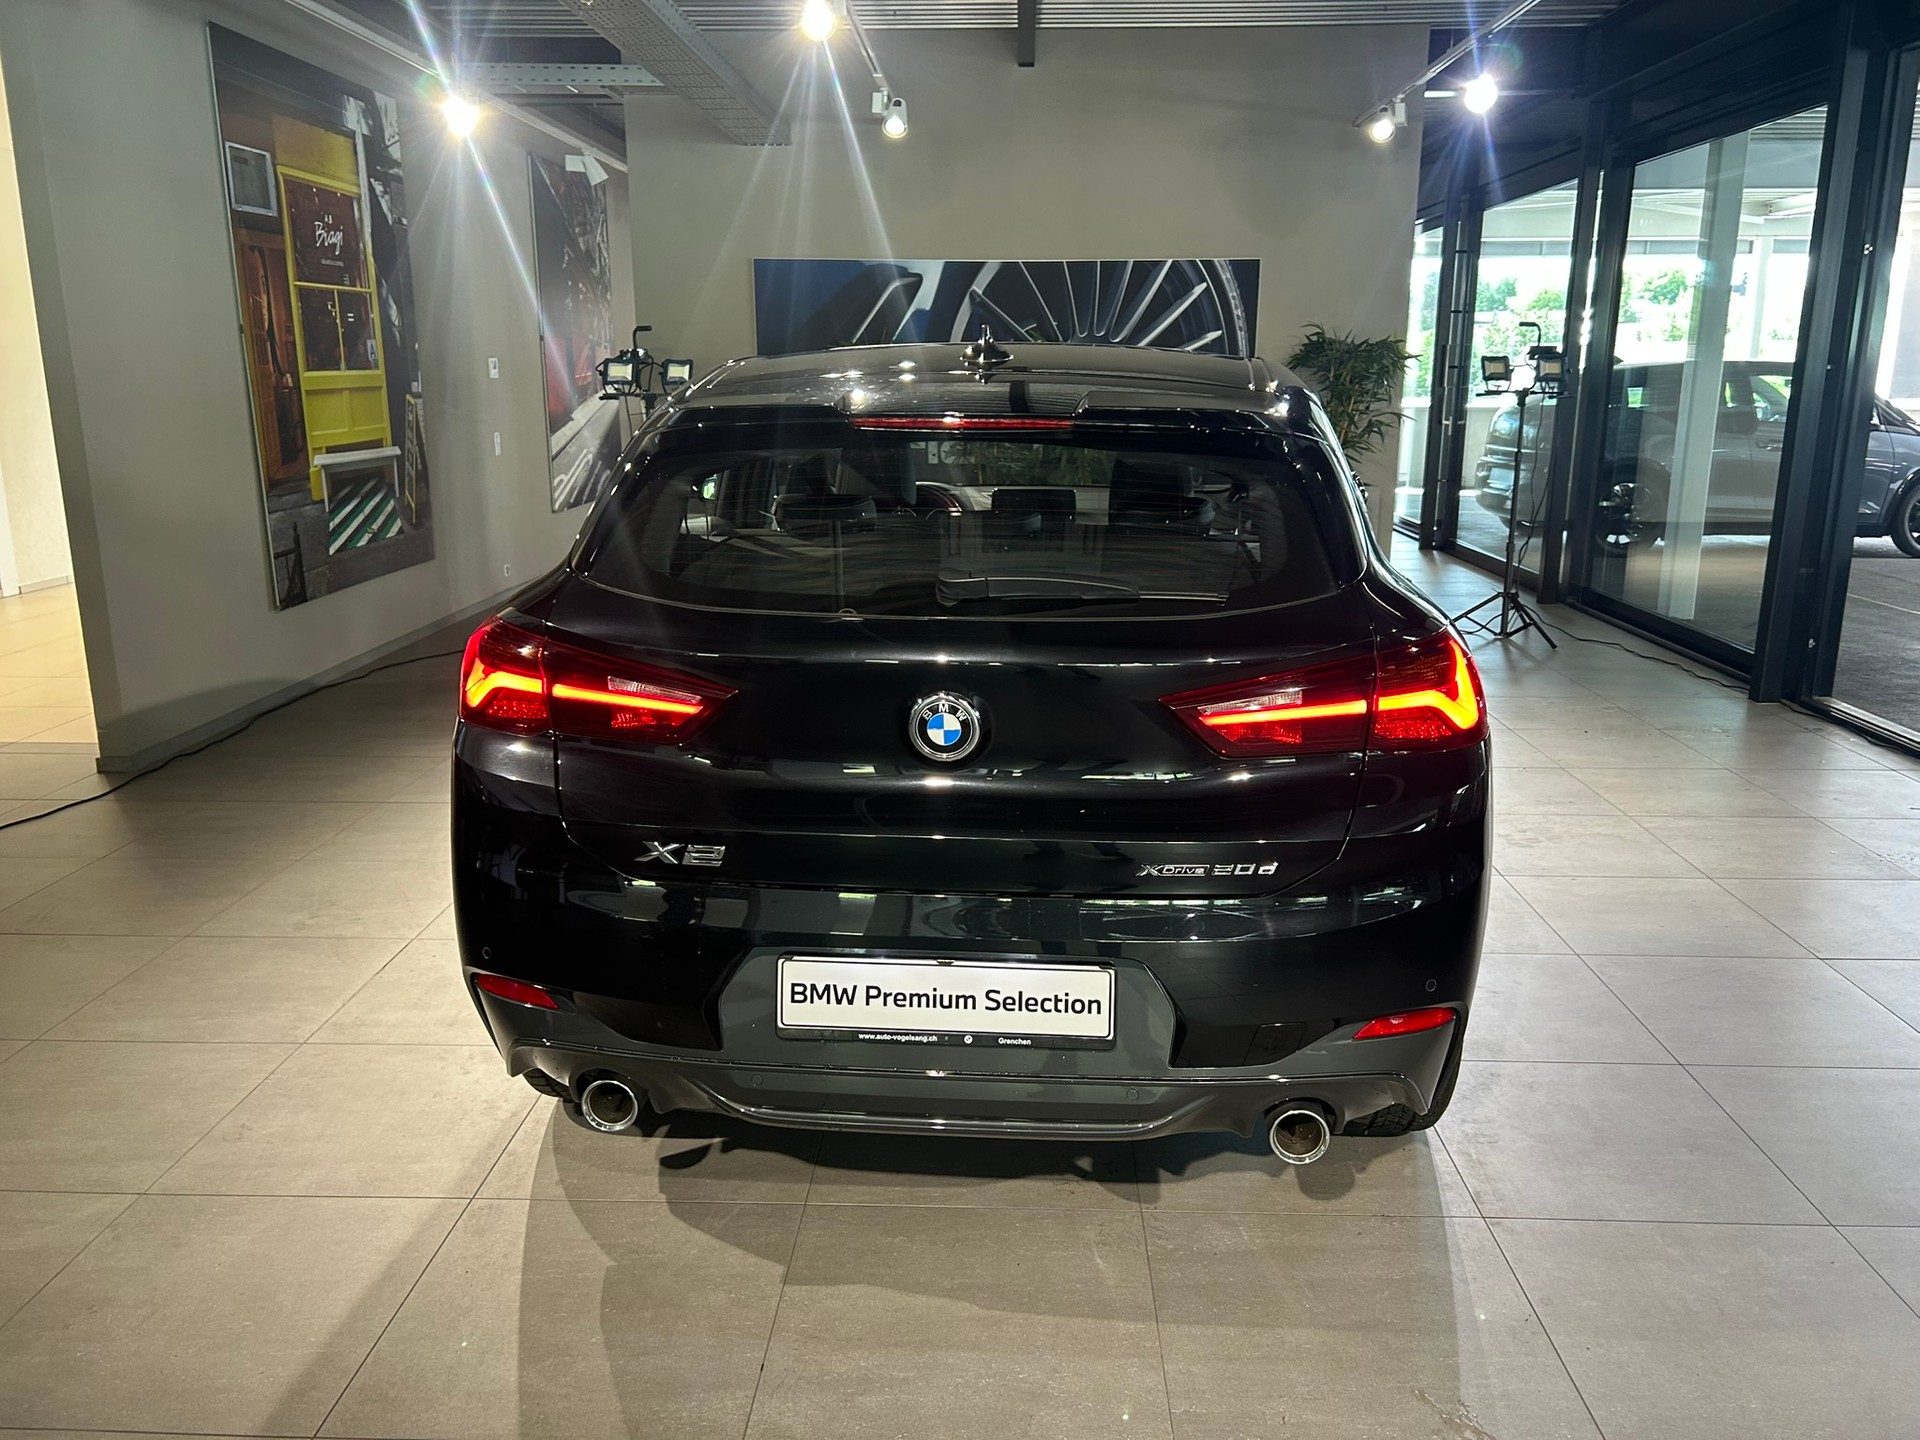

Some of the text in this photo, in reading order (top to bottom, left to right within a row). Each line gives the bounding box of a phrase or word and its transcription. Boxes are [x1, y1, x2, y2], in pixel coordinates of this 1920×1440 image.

[314, 221, 343, 255] Biagi
[922, 702, 968, 721] BMW
[633, 840, 726, 867] X2
[790, 982, 1102, 1015] BMW Premium Selection
[858, 1032, 938, 1044] www.auto-vogelsang.ch
[997, 1036, 1032, 1046] Grenchen
